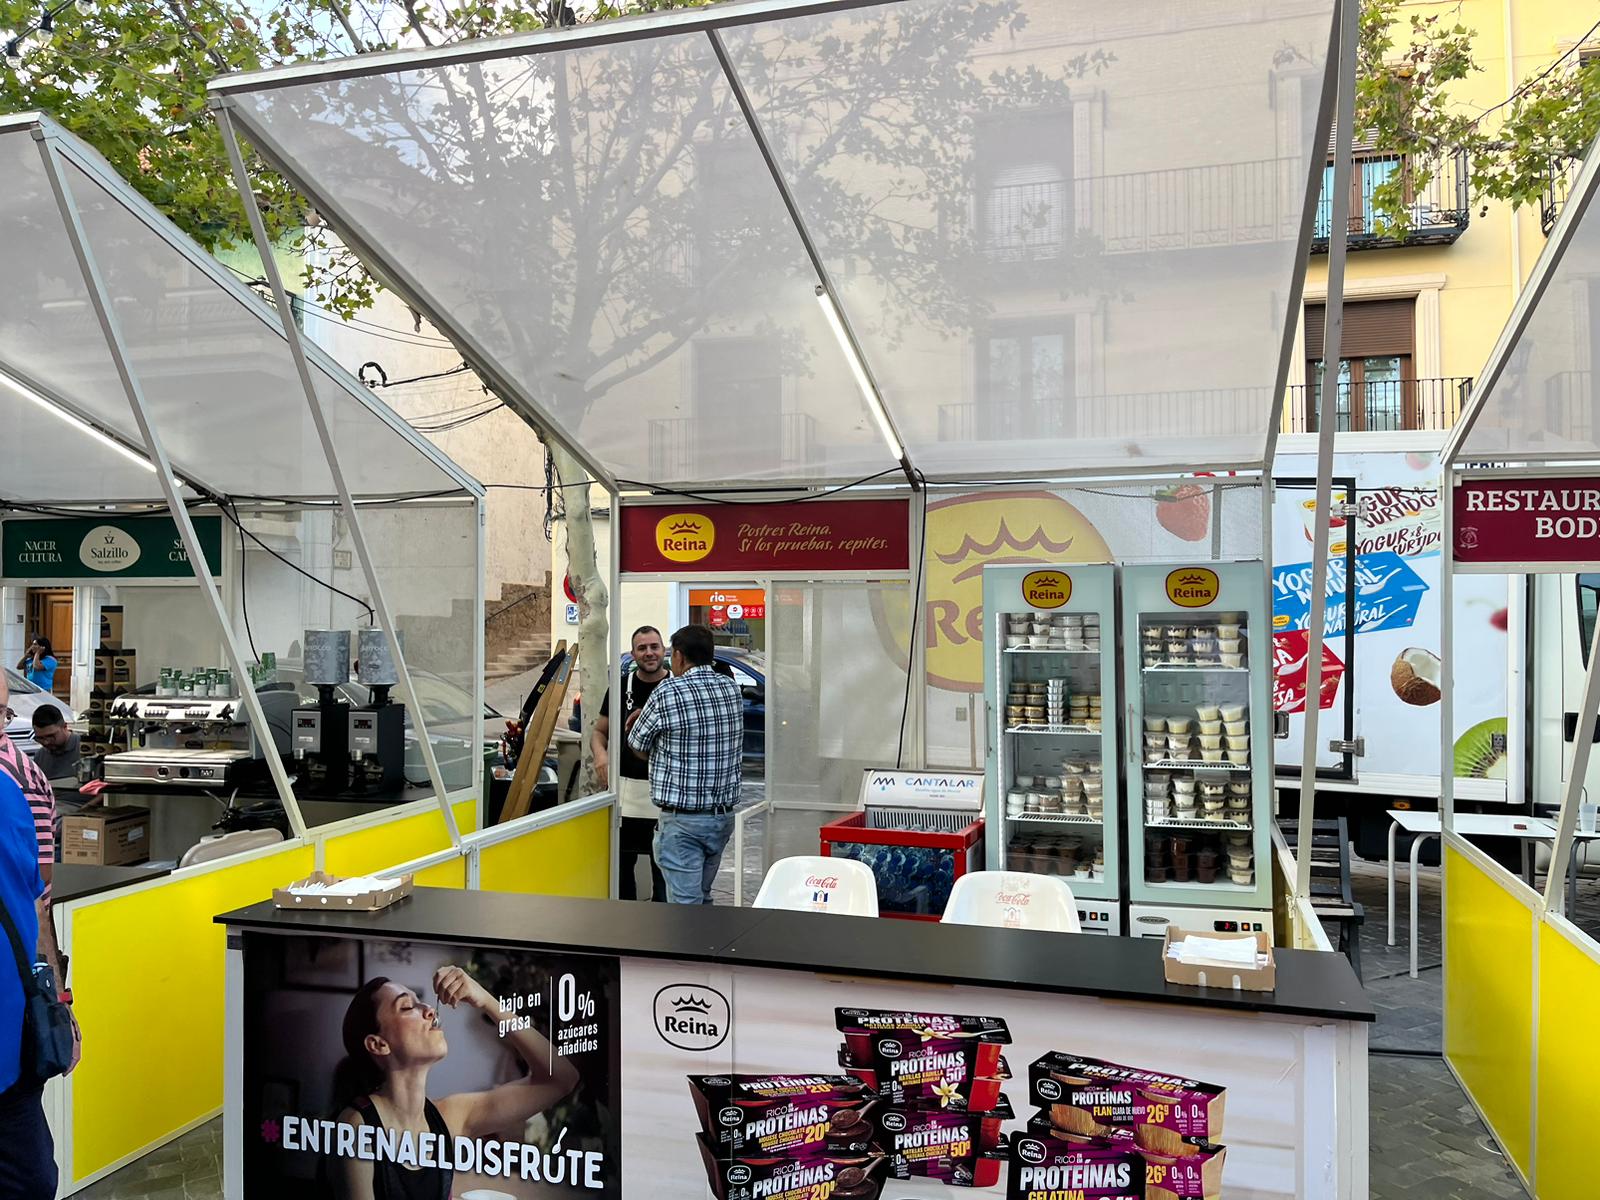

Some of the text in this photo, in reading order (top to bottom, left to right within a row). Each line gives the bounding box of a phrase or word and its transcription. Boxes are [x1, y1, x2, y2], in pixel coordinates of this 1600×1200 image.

[738, 523, 832, 537] Postres Reina.
[1535, 517, 1600, 538] BOD
[25, 541, 57, 550] NACER
[663, 538, 707, 551] Reina
[738, 536, 888, 557] Si los pruebas, repites.
[19, 552, 62, 563] CULTURA
[91, 547, 129, 559] Salzillo
[710, 592, 725, 602] ria
[1029, 590, 1065, 600] Reina
[1173, 588, 1211, 598] Reina
[905, 778, 975, 788] CANTALAR
[499, 992, 541, 1015] bajo en
[558, 973, 595, 1022] 0%
[498, 1015, 531, 1038] grasa
[558, 1023, 598, 1040] azúcares
[665, 1016, 718, 1037] Reina
[558, 1038, 598, 1057] añadidos
[891, 1050, 966, 1077] PROTEÍNAS
[1072, 1087, 1132, 1105] PROTEÍNAS
[722, 1114, 740, 1122] Reina
[766, 1107, 788, 1118] RICO
[1093, 1106, 1112, 1116] FLAN
[745, 1105, 829, 1140] PROTEÍNAS
[894, 1125, 969, 1150] PROTEÍNAS
[1021, 1149, 1042, 1159] Reina
[1054, 1155, 1075, 1164] RICO
[772, 1165, 795, 1177] RICO
[1019, 1158, 1131, 1191] PROTEÍNAS
[752, 1162, 834, 1199] PROTEÍNAS
